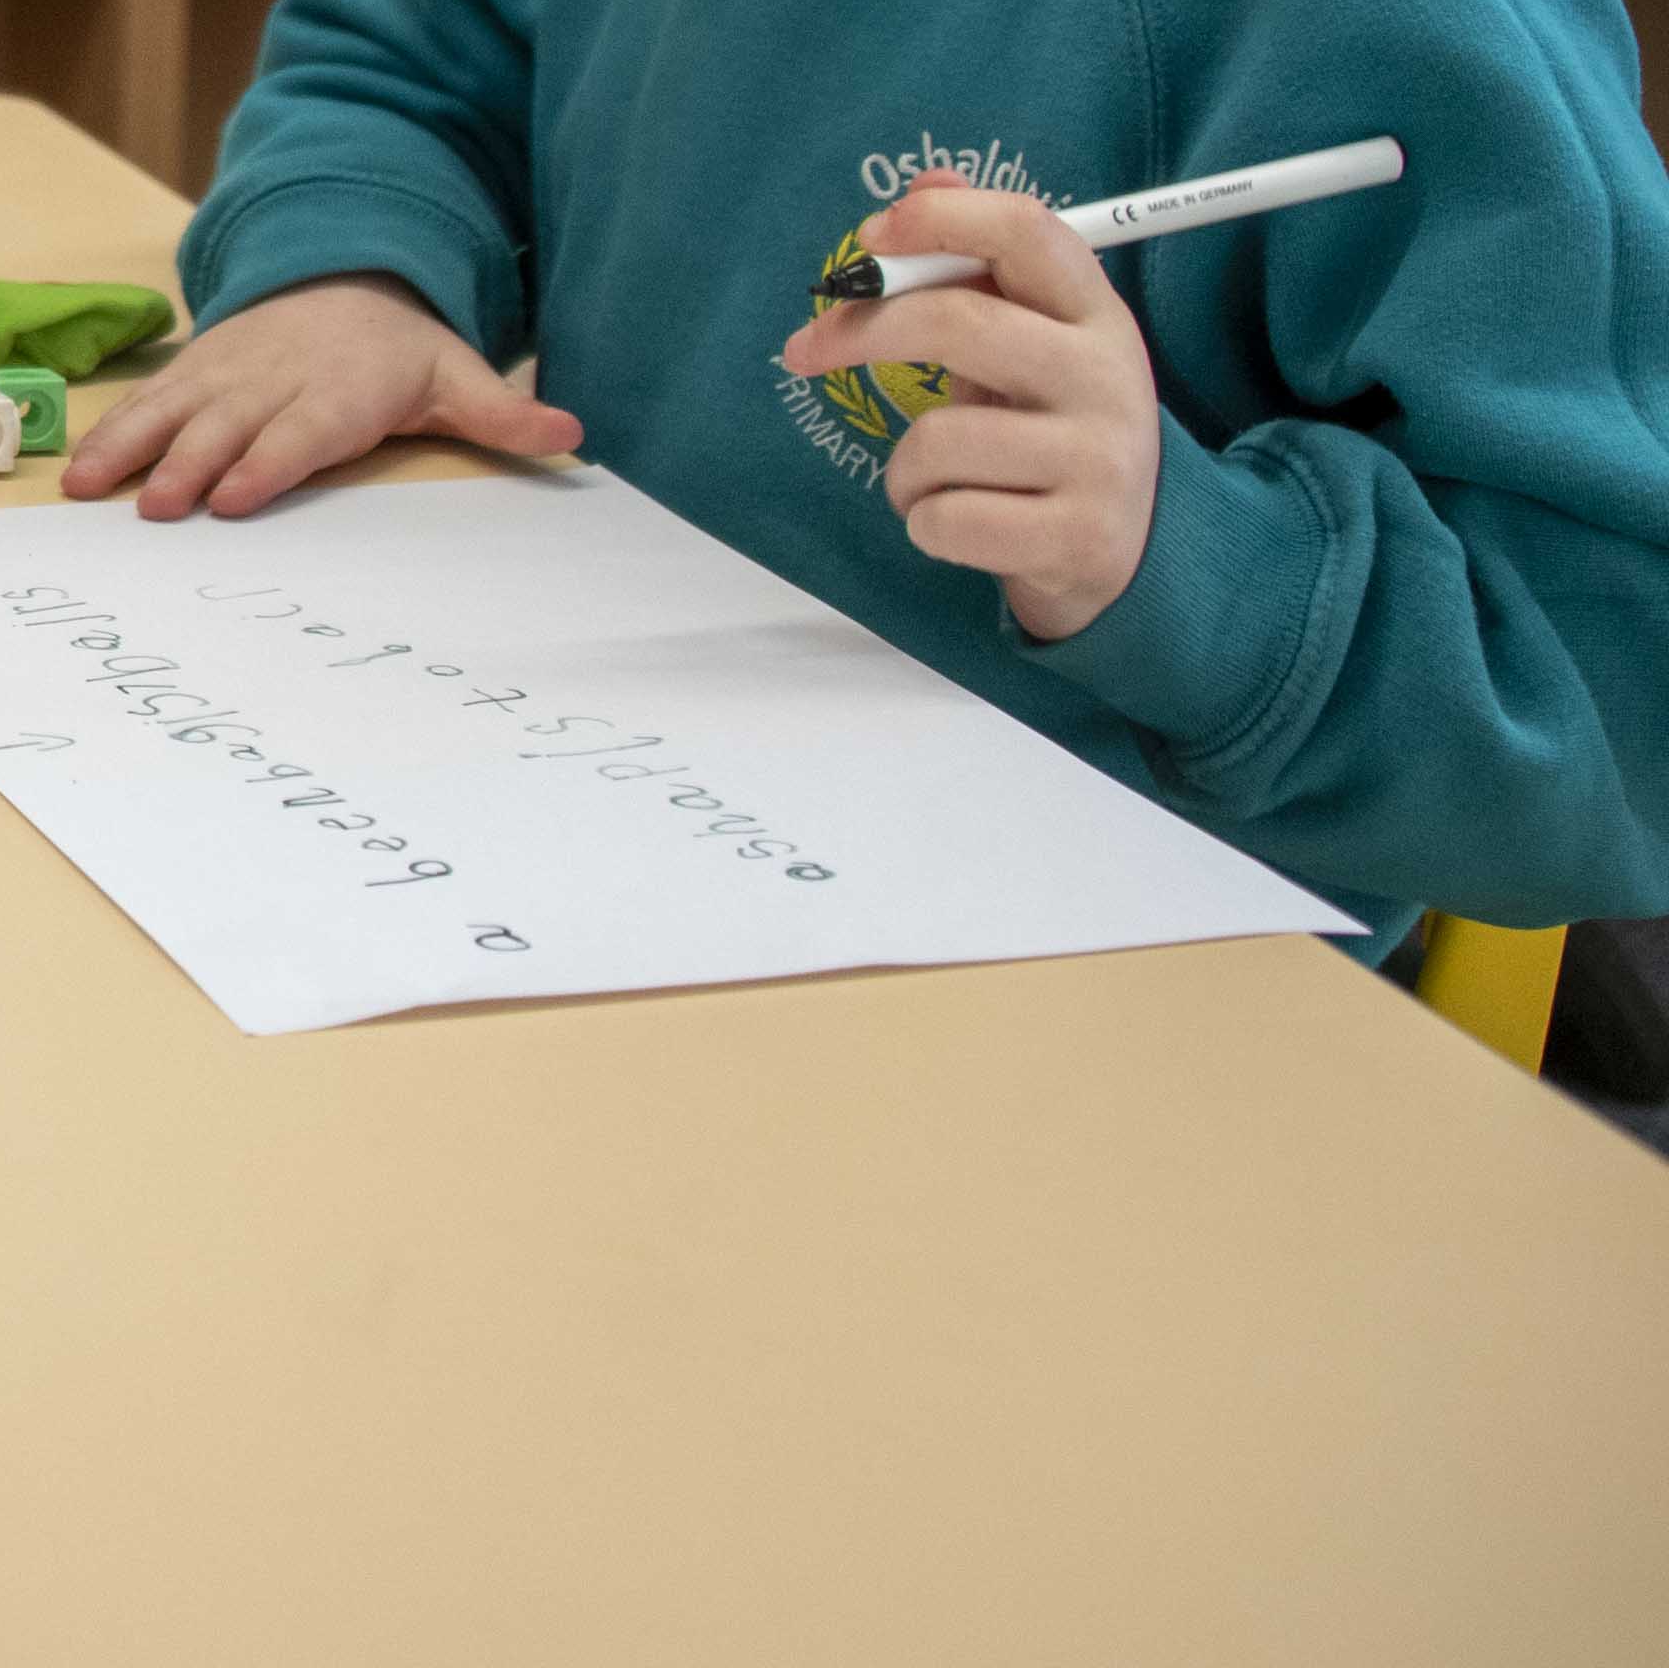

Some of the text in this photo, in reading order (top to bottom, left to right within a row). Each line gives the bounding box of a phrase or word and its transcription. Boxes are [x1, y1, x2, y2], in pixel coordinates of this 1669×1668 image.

[1147, 196, 1181, 214] MADE
[1184, 192, 1197, 206] IN
[1199, 179, 1254, 204] GERMANY
[769, 355, 887, 489] RIMARY
